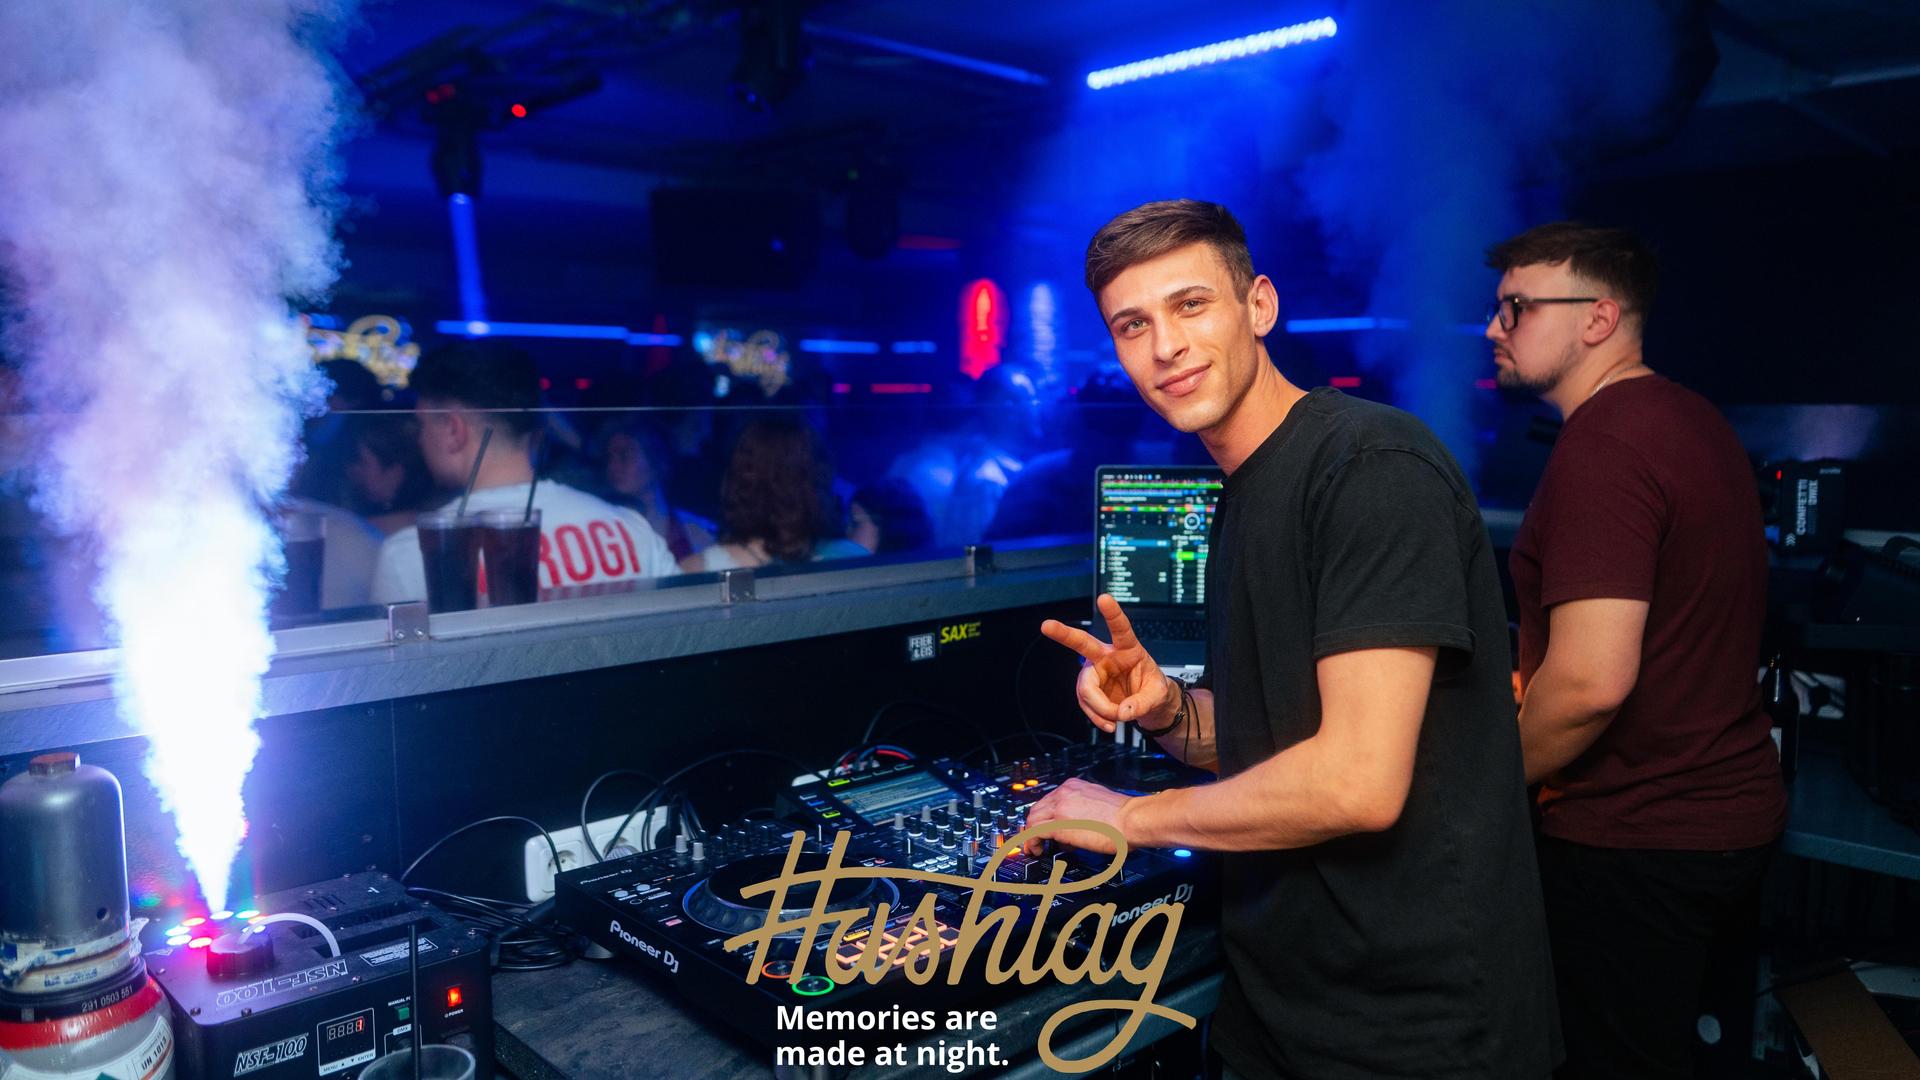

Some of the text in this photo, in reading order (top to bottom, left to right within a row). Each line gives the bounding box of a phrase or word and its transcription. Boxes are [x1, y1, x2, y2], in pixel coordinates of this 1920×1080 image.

[538, 519, 641, 590] ROGI
[940, 623, 968, 644] SAX
[1111, 894, 1171, 927] ioneer
[610, 920, 661, 958] Pioneer
[217, 958, 348, 1008] NSF-100
[82, 1000, 98, 1012] 291
[141, 1056, 152, 1070] UN
[154, 1036, 167, 1057] 1013
[234, 1033, 308, 1077] NSF-100
